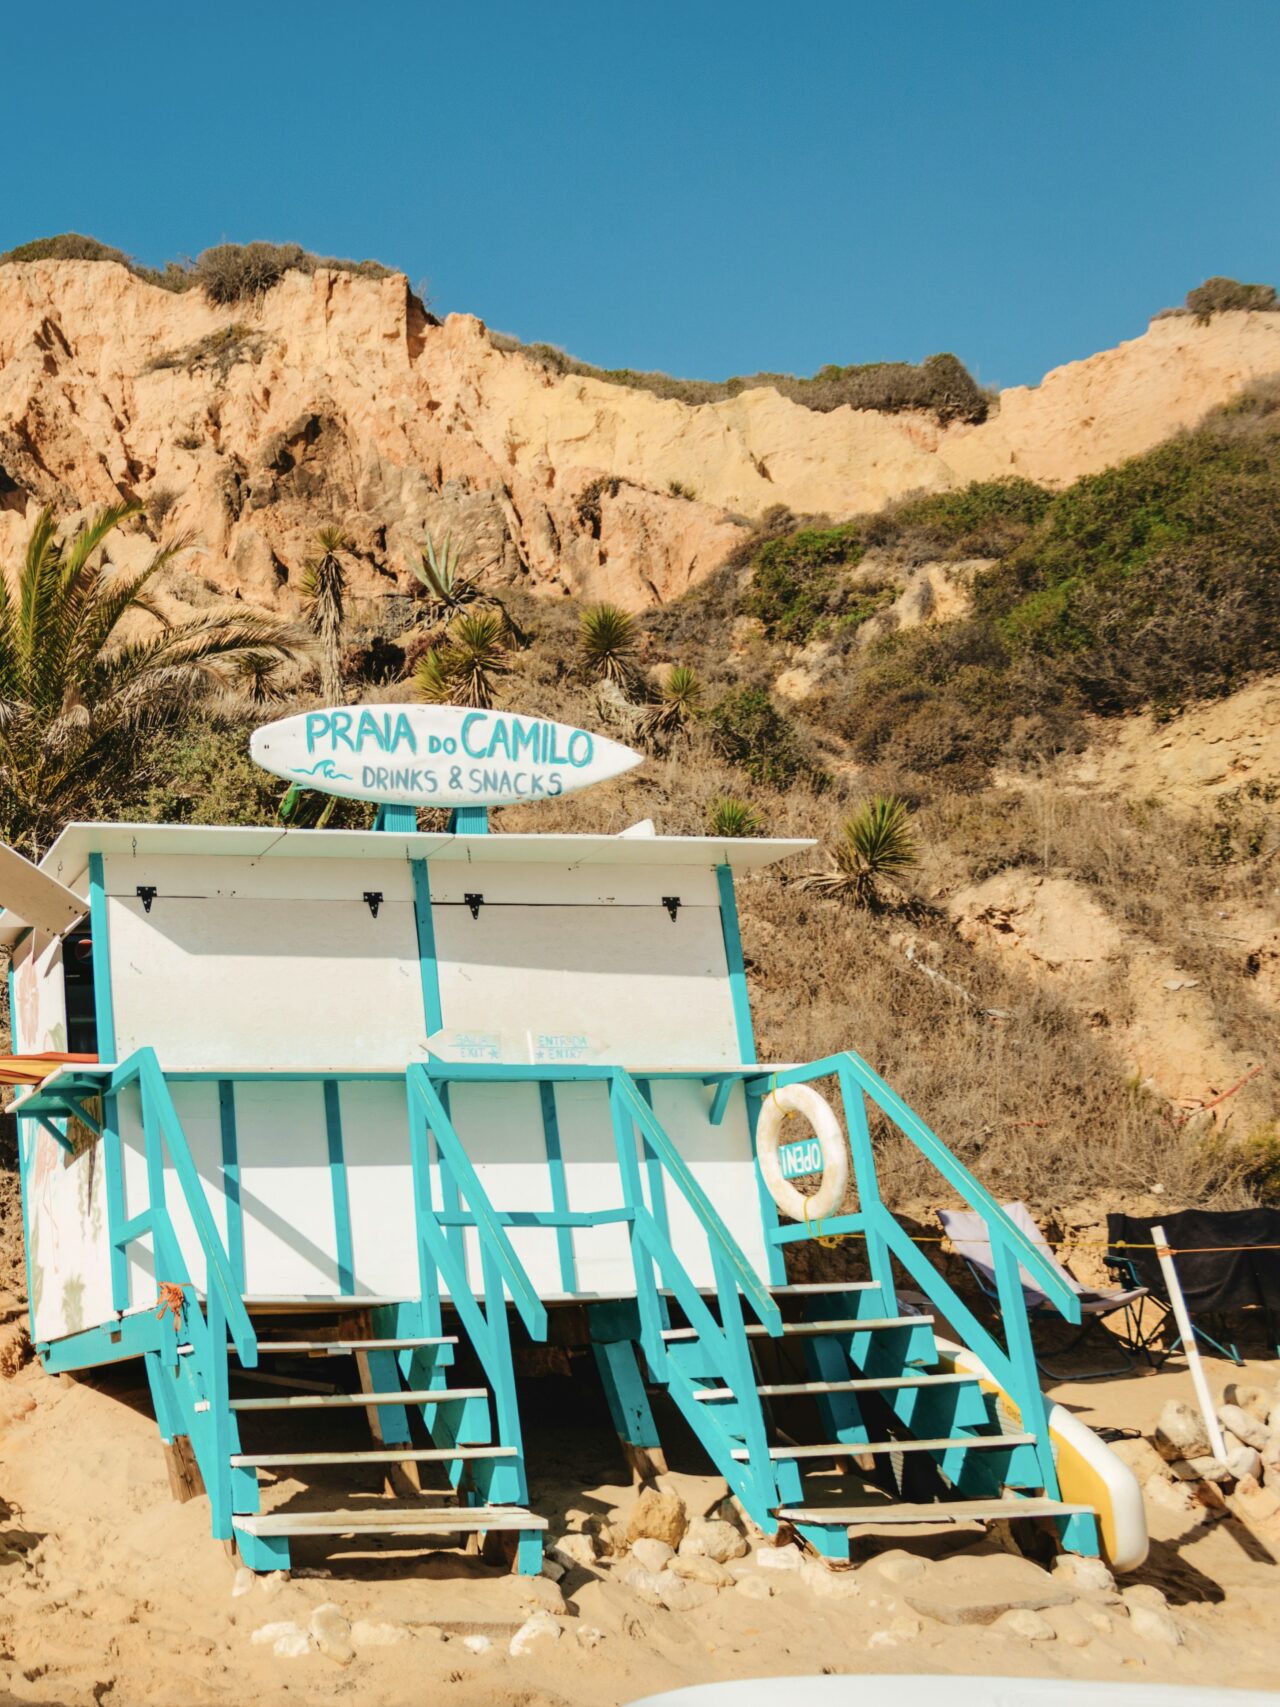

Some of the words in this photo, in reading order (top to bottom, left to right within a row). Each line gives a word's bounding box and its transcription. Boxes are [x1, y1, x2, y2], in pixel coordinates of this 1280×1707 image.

[306, 709, 418, 755] PRAIA
[428, 735, 457, 755] DO
[461, 712, 593, 768] CAMILO
[362, 765, 439, 793] DRINKS
[448, 765, 463, 790] &
[469, 768, 563, 796] SNACKS
[778, 1143, 821, 1176] OPEN!
